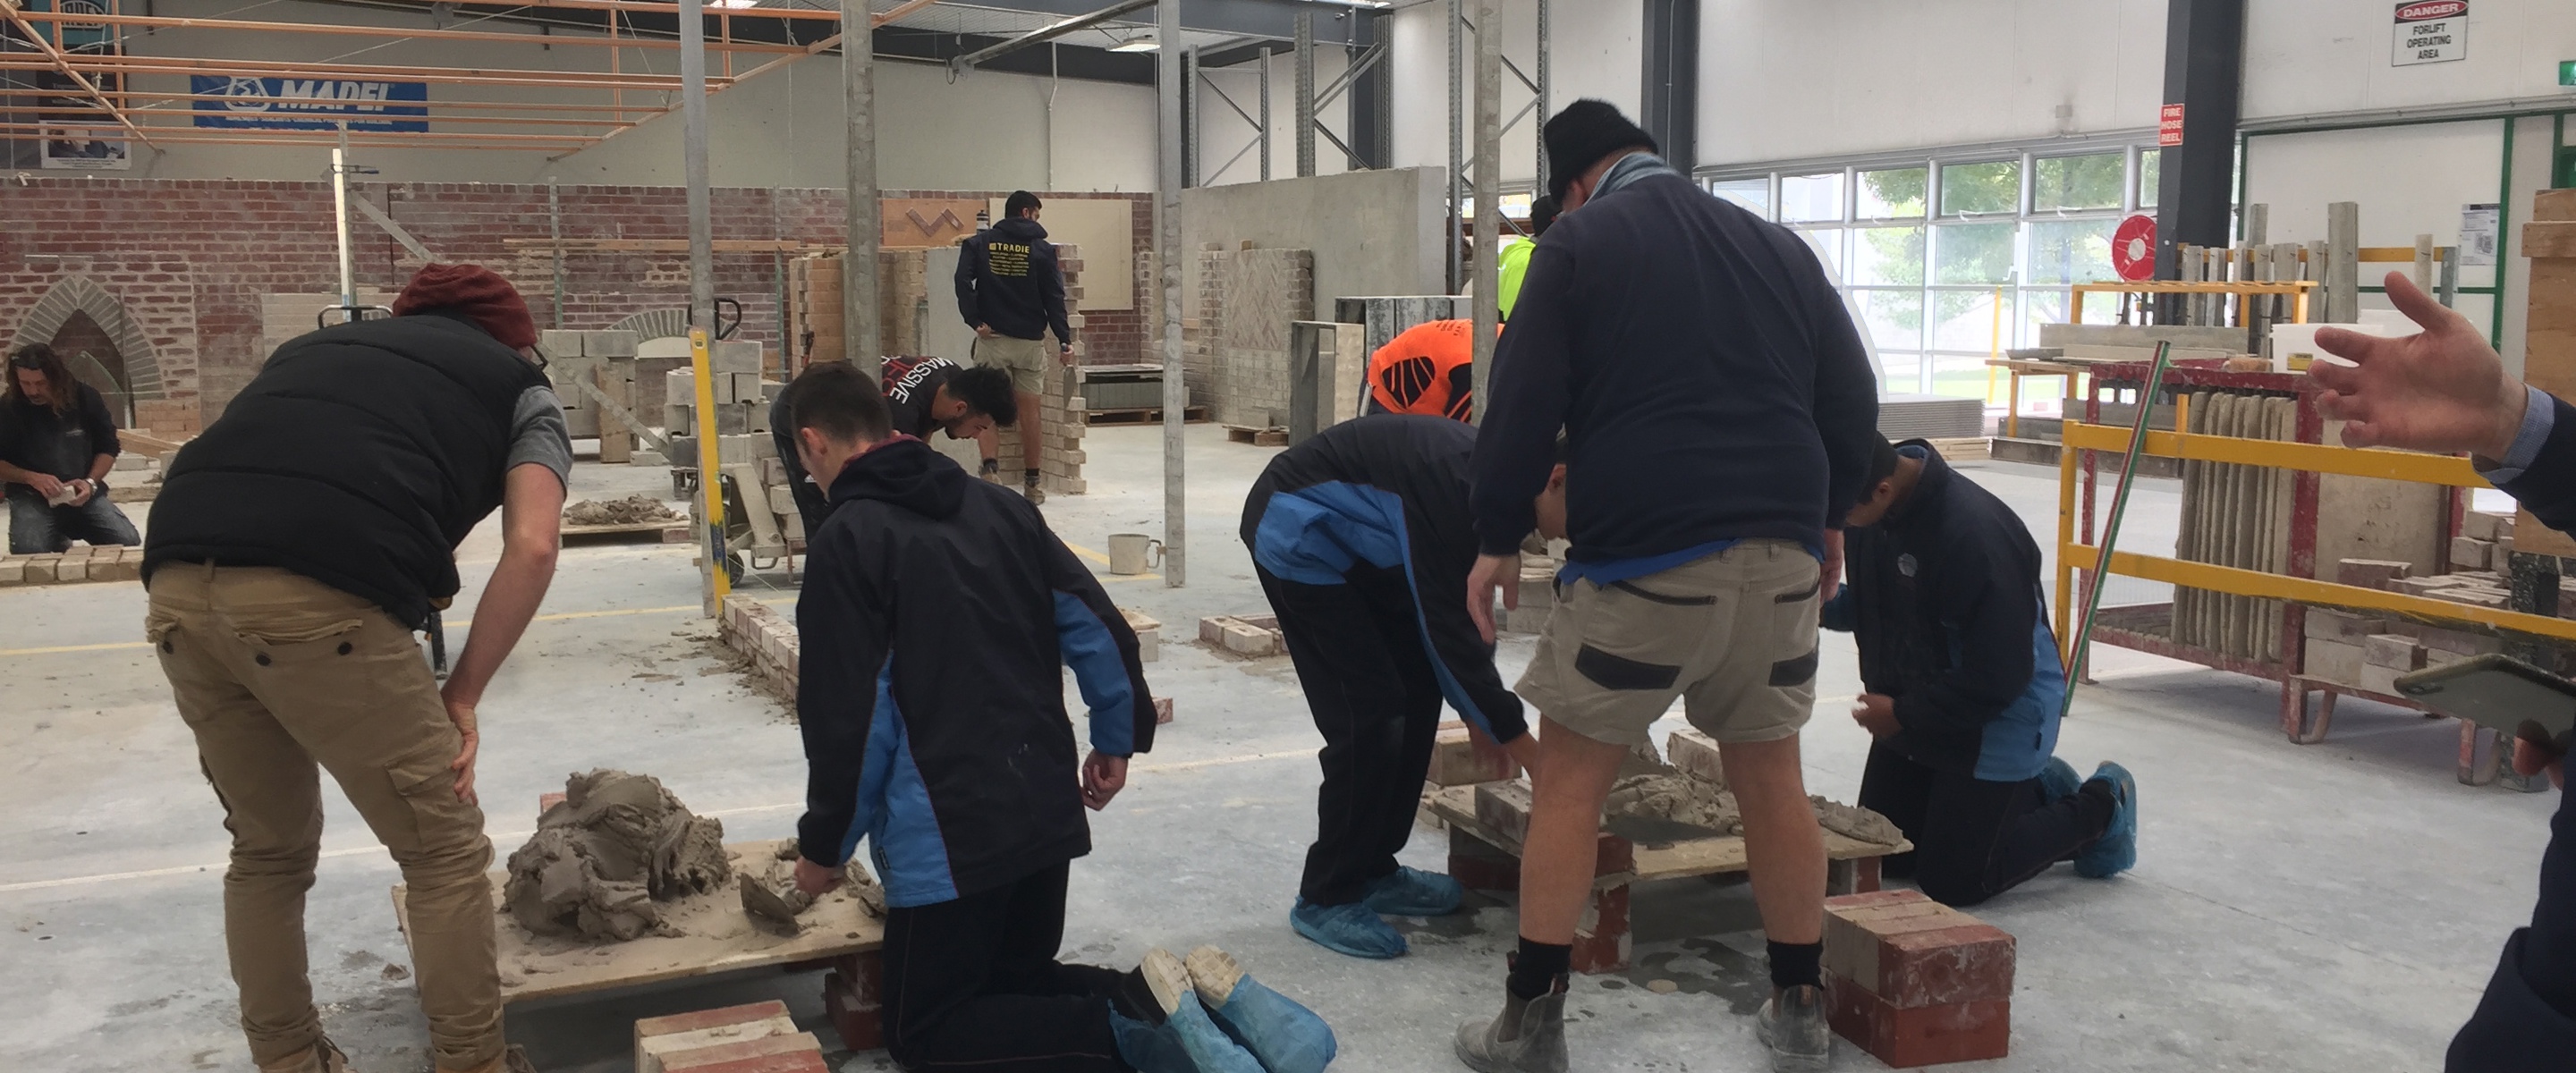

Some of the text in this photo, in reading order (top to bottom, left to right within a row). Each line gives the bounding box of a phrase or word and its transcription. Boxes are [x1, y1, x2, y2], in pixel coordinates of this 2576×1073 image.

[2403, 4, 2459, 17] DANGER
[2407, 35, 2451, 48] OPERATING
[2418, 49, 2438, 59] AREA
[278, 80, 389, 111] MAPEI
[2164, 107, 2181, 117] FIRE
[2160, 120, 2182, 130] HOSE
[2161, 132, 2181, 143] REEL
[996, 242, 1030, 254] TRADIE
[889, 357, 954, 404] MASSIVE
